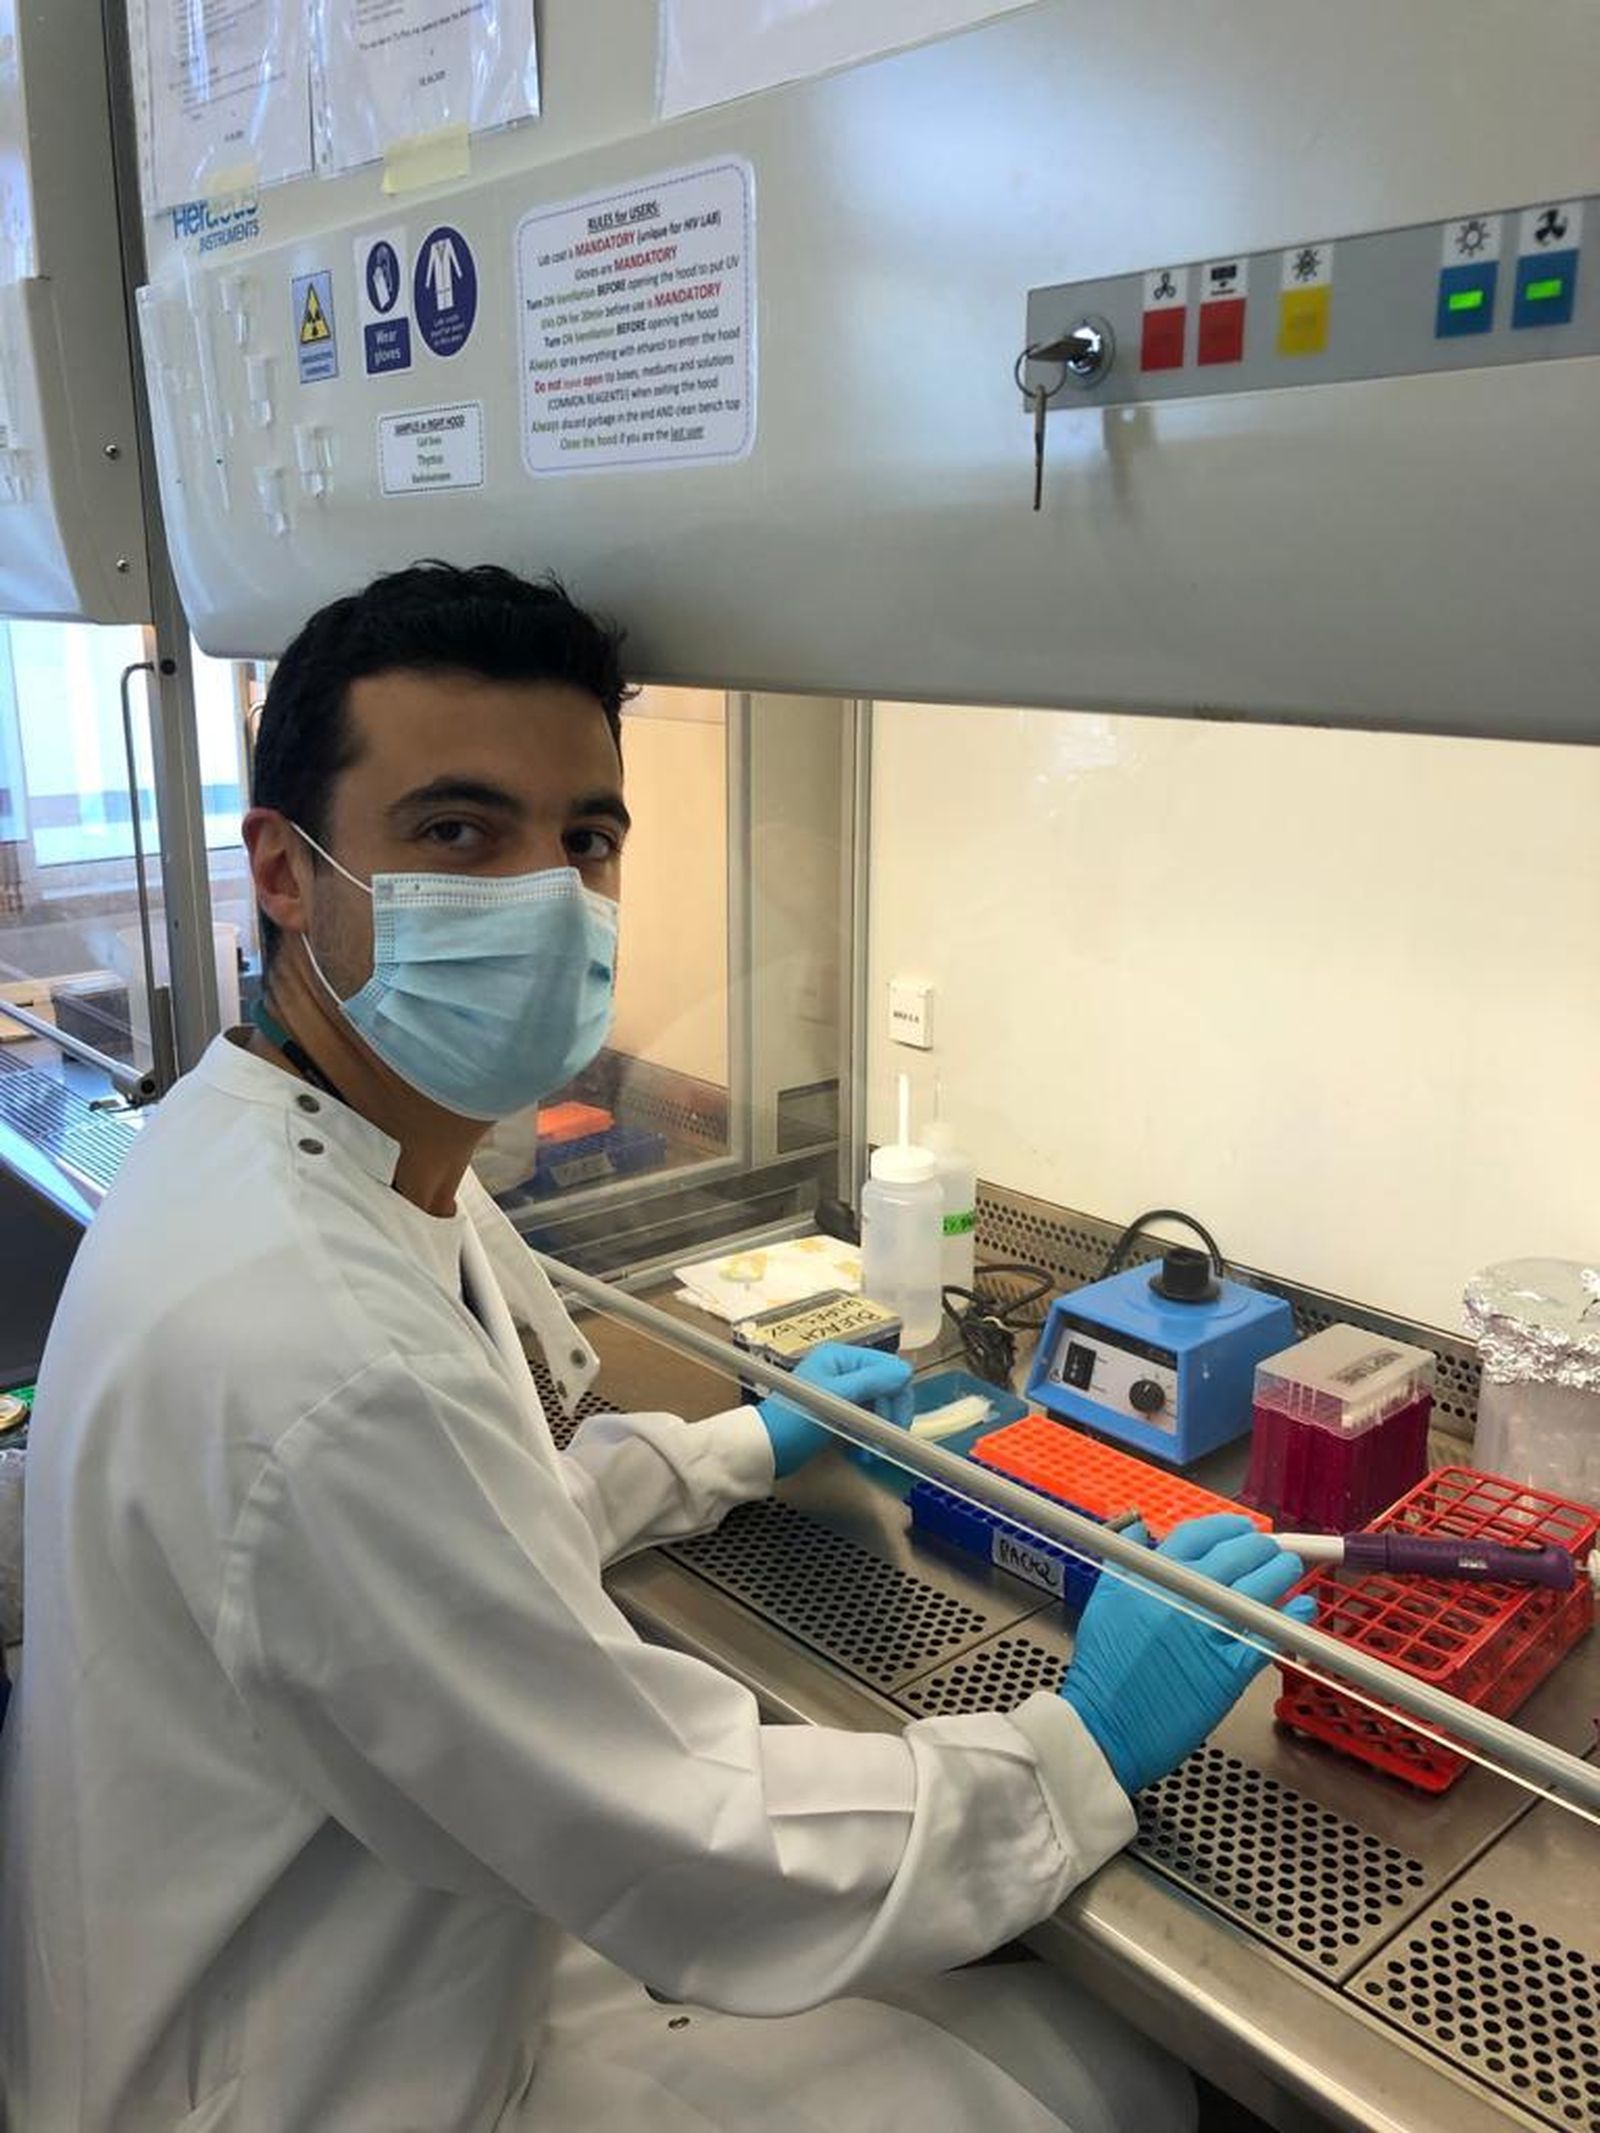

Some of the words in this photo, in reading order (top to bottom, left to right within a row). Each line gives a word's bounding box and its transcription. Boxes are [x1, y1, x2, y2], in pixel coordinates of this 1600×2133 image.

[200, 219, 260, 253] INSTRUMENTS
[588, 212, 613, 233] RULES
[615, 209, 628, 225] for
[575, 231, 635, 258] MANDATORY
[669, 221, 682, 235] for
[574, 267, 599, 282] Gloves
[614, 245, 678, 272] MANDATORY
[597, 278, 626, 297] BEFORE
[627, 273, 659, 292] opening
[660, 271, 673, 284] the
[675, 264, 697, 280] hood
[710, 259, 724, 276] put
[725, 254, 740, 270] UV
[605, 302, 631, 318] before
[655, 281, 721, 307] MANDATORY
[374, 329, 398, 344] Wear
[544, 335, 561, 349] Turn
[616, 319, 646, 336] BEFORE
[647, 313, 680, 331] opening
[681, 310, 695, 324] the
[697, 304, 719, 320] hood
[374, 347, 402, 368] gloves
[529, 358, 559, 373] Always
[579, 348, 617, 365] everything
[619, 344, 636, 358] with
[637, 339, 667, 355] ethanol
[702, 330, 716, 344] the
[717, 325, 740, 341] hood
[534, 379, 546, 395] Do
[547, 377, 561, 392] not
[583, 373, 604, 388] open
[642, 363, 678, 378] mediums
[680, 359, 695, 373] and
[696, 353, 735, 370] solutions
[631, 386, 653, 399] when
[681, 381, 695, 394] the
[697, 374, 719, 391] hood
[531, 420, 559, 435] Always
[626, 410, 639, 424] the
[656, 403, 674, 418] AND
[597, 431, 617, 447] hood
[626, 431, 640, 447] you
[642, 431, 655, 443] are
[656, 428, 669, 441] the
[800, 1308, 882, 1342] BLEACH
